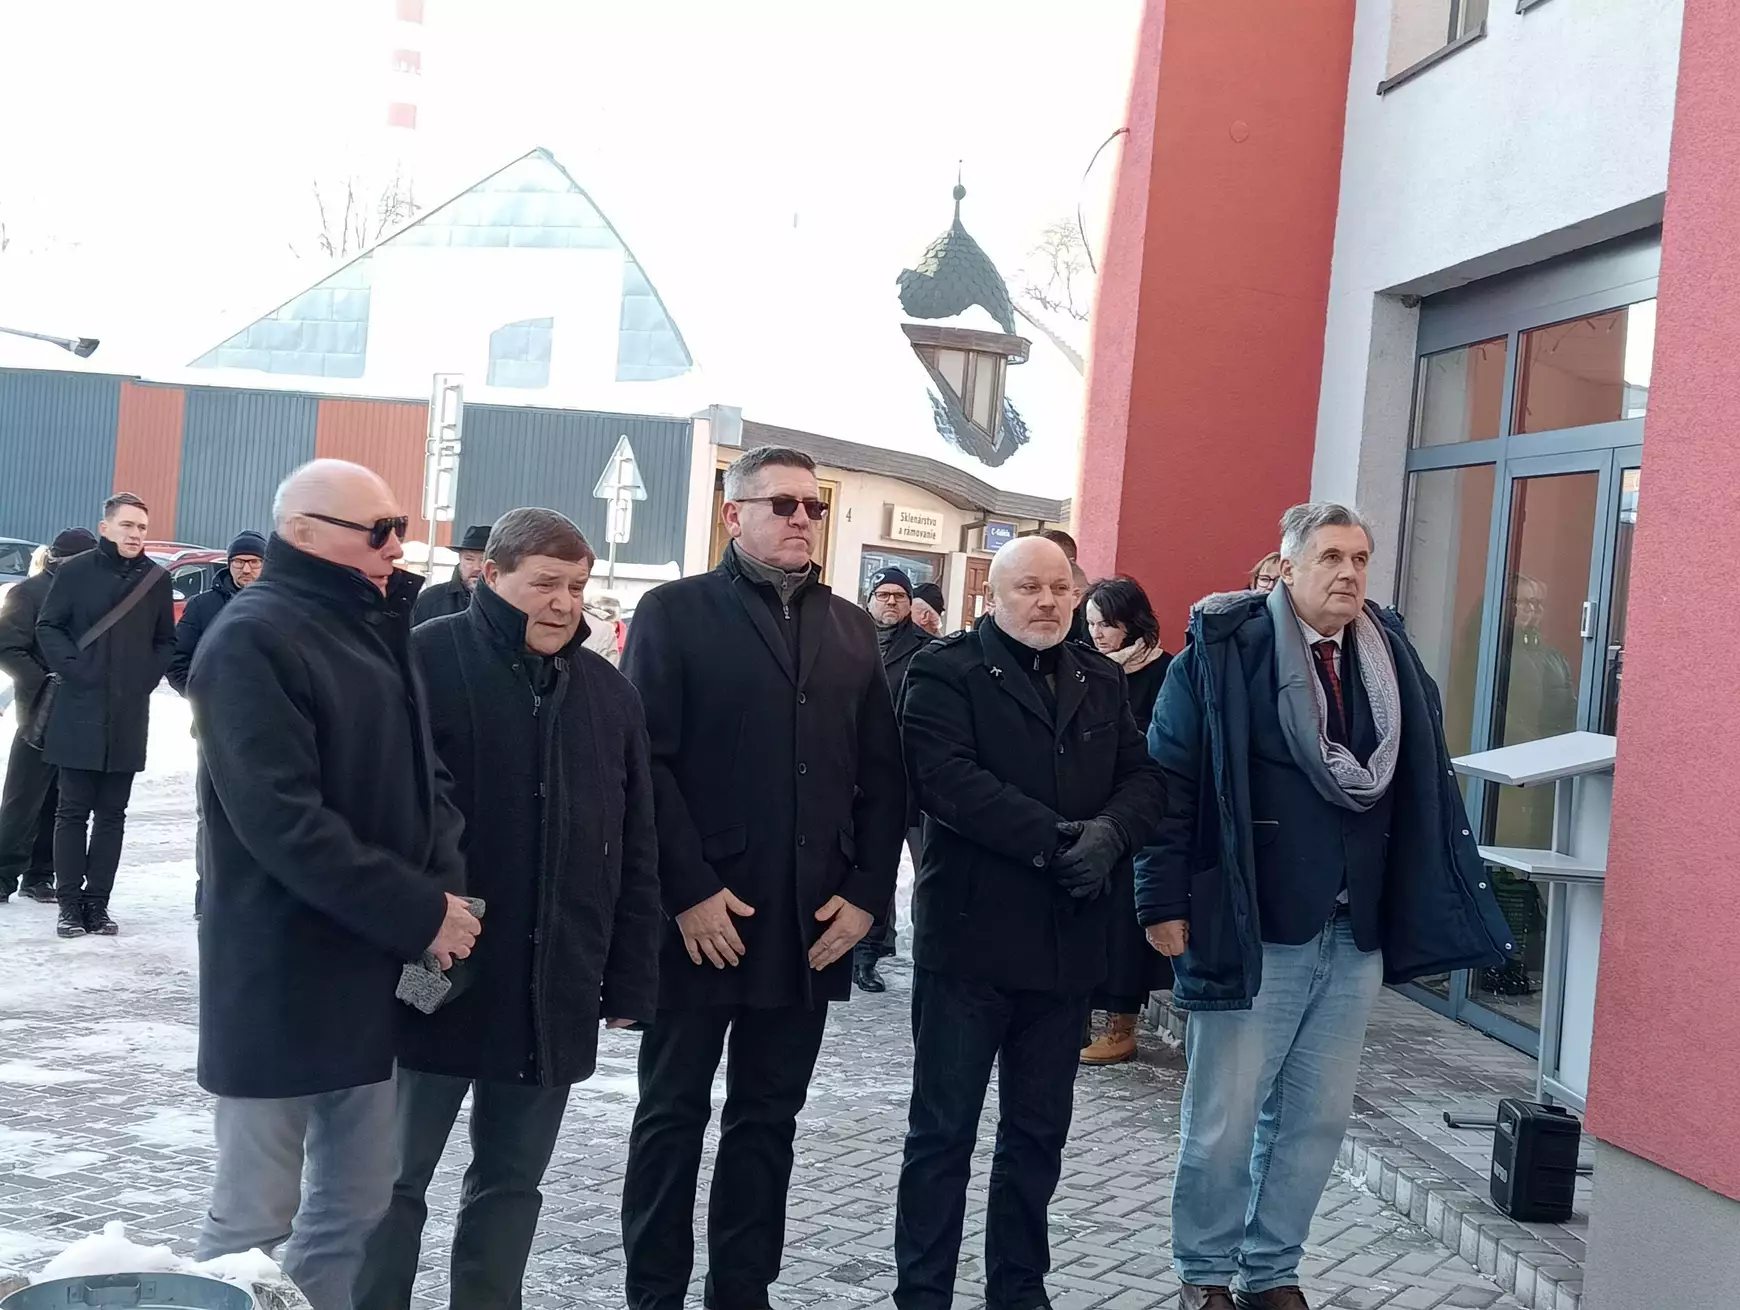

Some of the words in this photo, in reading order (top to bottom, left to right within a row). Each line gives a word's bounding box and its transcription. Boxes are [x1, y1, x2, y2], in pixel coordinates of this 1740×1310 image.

[846, 507, 852, 522] 4
[900, 511, 937, 526] Sklenárstvo
[898, 527, 902, 535] a
[903, 526, 936, 540] rámovanie
